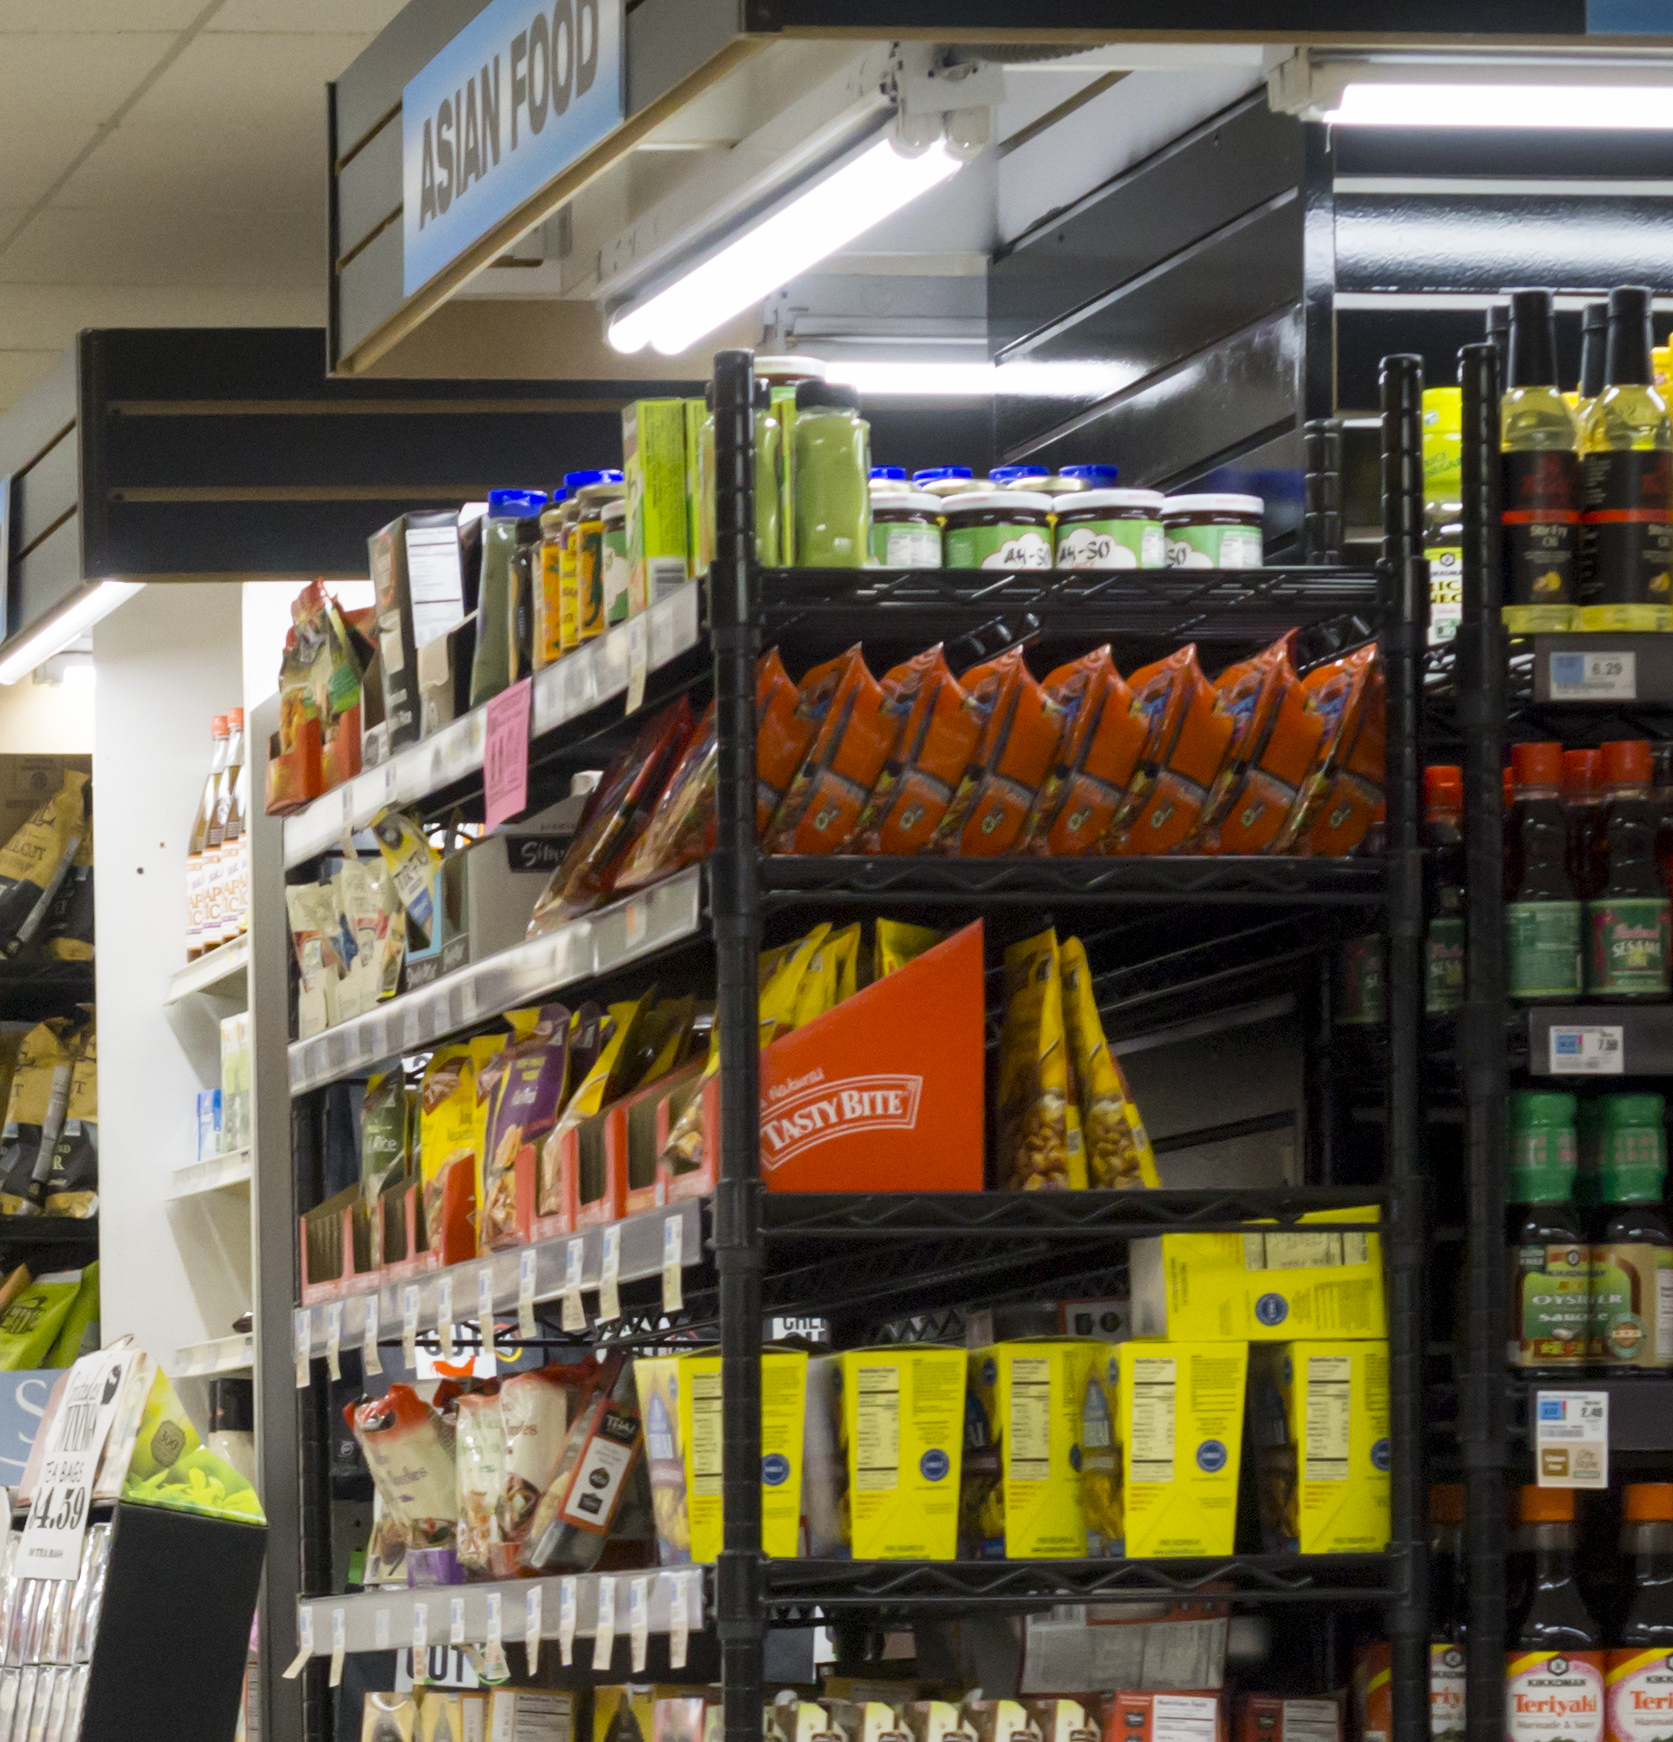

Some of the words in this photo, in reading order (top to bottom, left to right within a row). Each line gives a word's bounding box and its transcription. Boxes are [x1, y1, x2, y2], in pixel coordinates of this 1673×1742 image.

[418, 54, 501, 231] ASIAN
[510, 0, 600, 153] FOOD
[1514, 1692, 1598, 1718] Teriyaki
[1630, 1689, 1673, 1711] Teri
